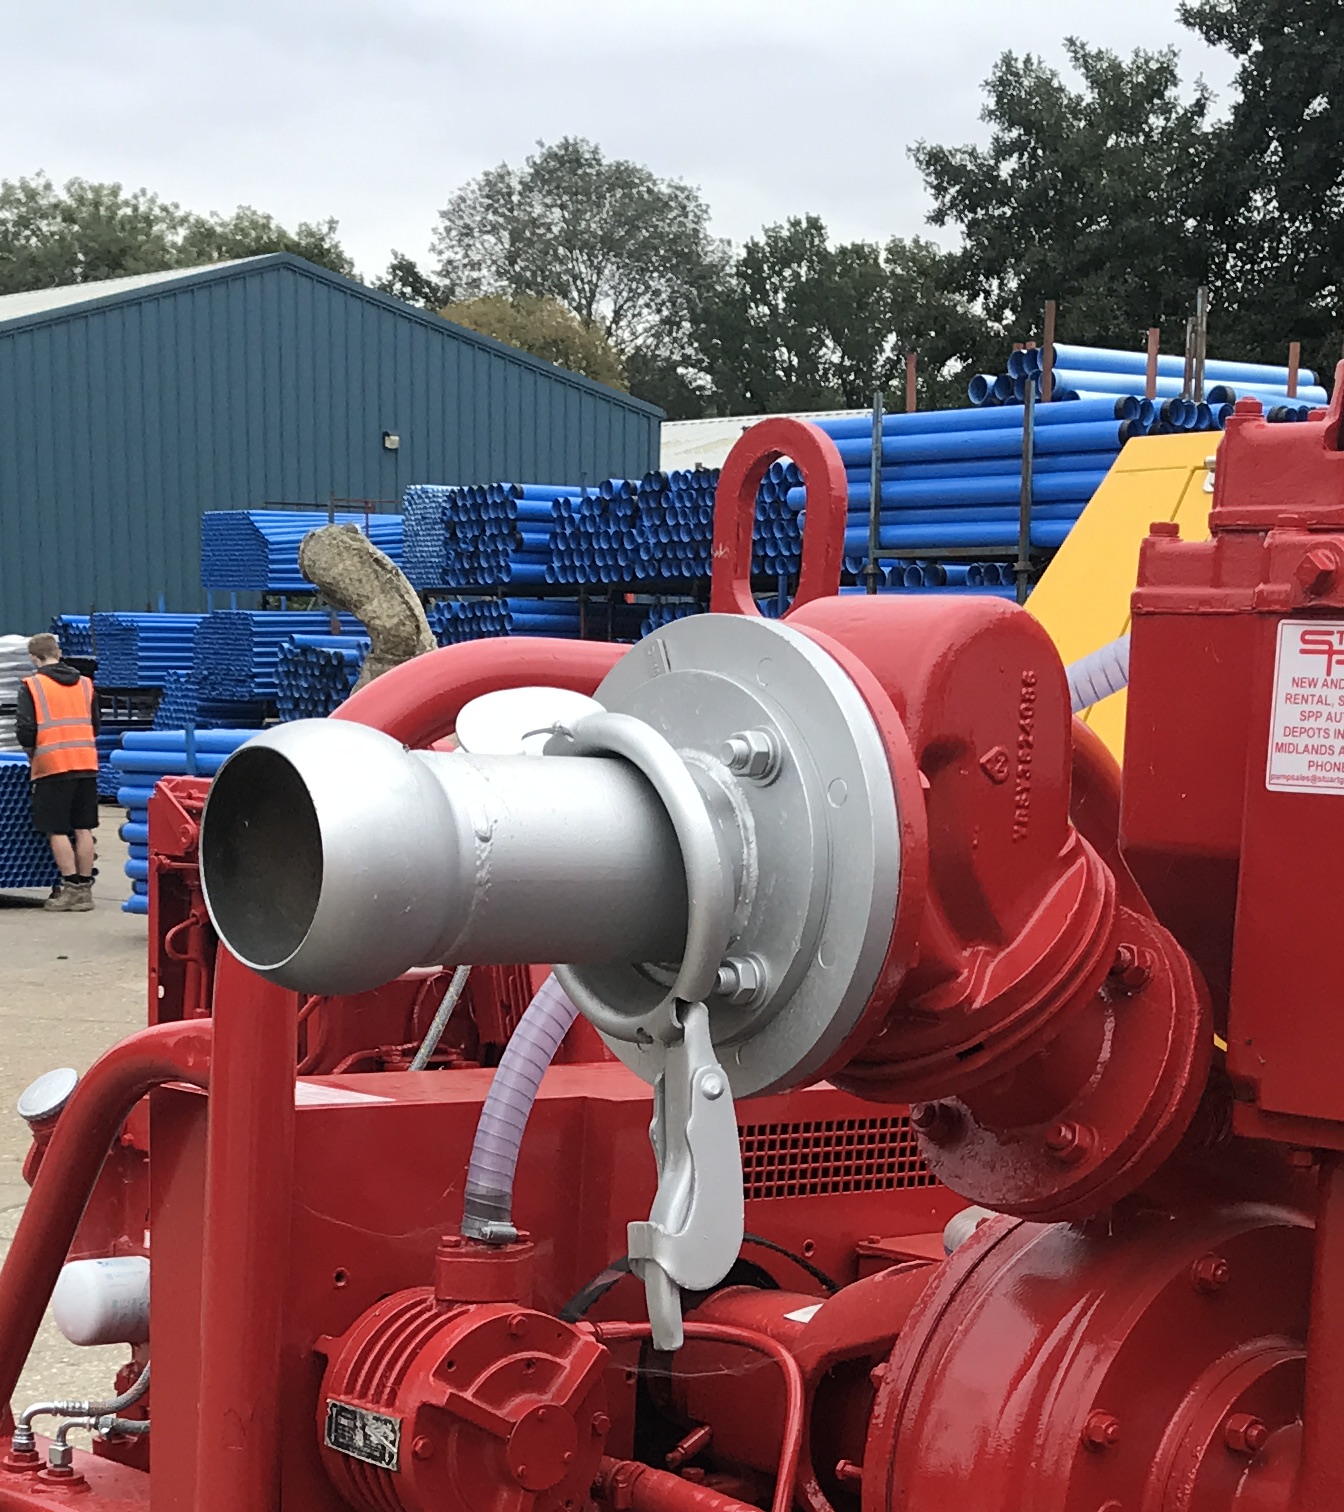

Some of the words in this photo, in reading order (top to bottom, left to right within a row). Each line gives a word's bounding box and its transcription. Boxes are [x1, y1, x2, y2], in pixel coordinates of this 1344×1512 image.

[1291, 676, 1318, 689] NEW
[1284, 693, 1335, 708] RENTAL,
[1299, 710, 1322, 722] SPP
[1283, 726, 1330, 739] DEPOTS
[1333, 728, 1344, 740] IN
[1275, 742, 1335, 757] MIDLANDS
